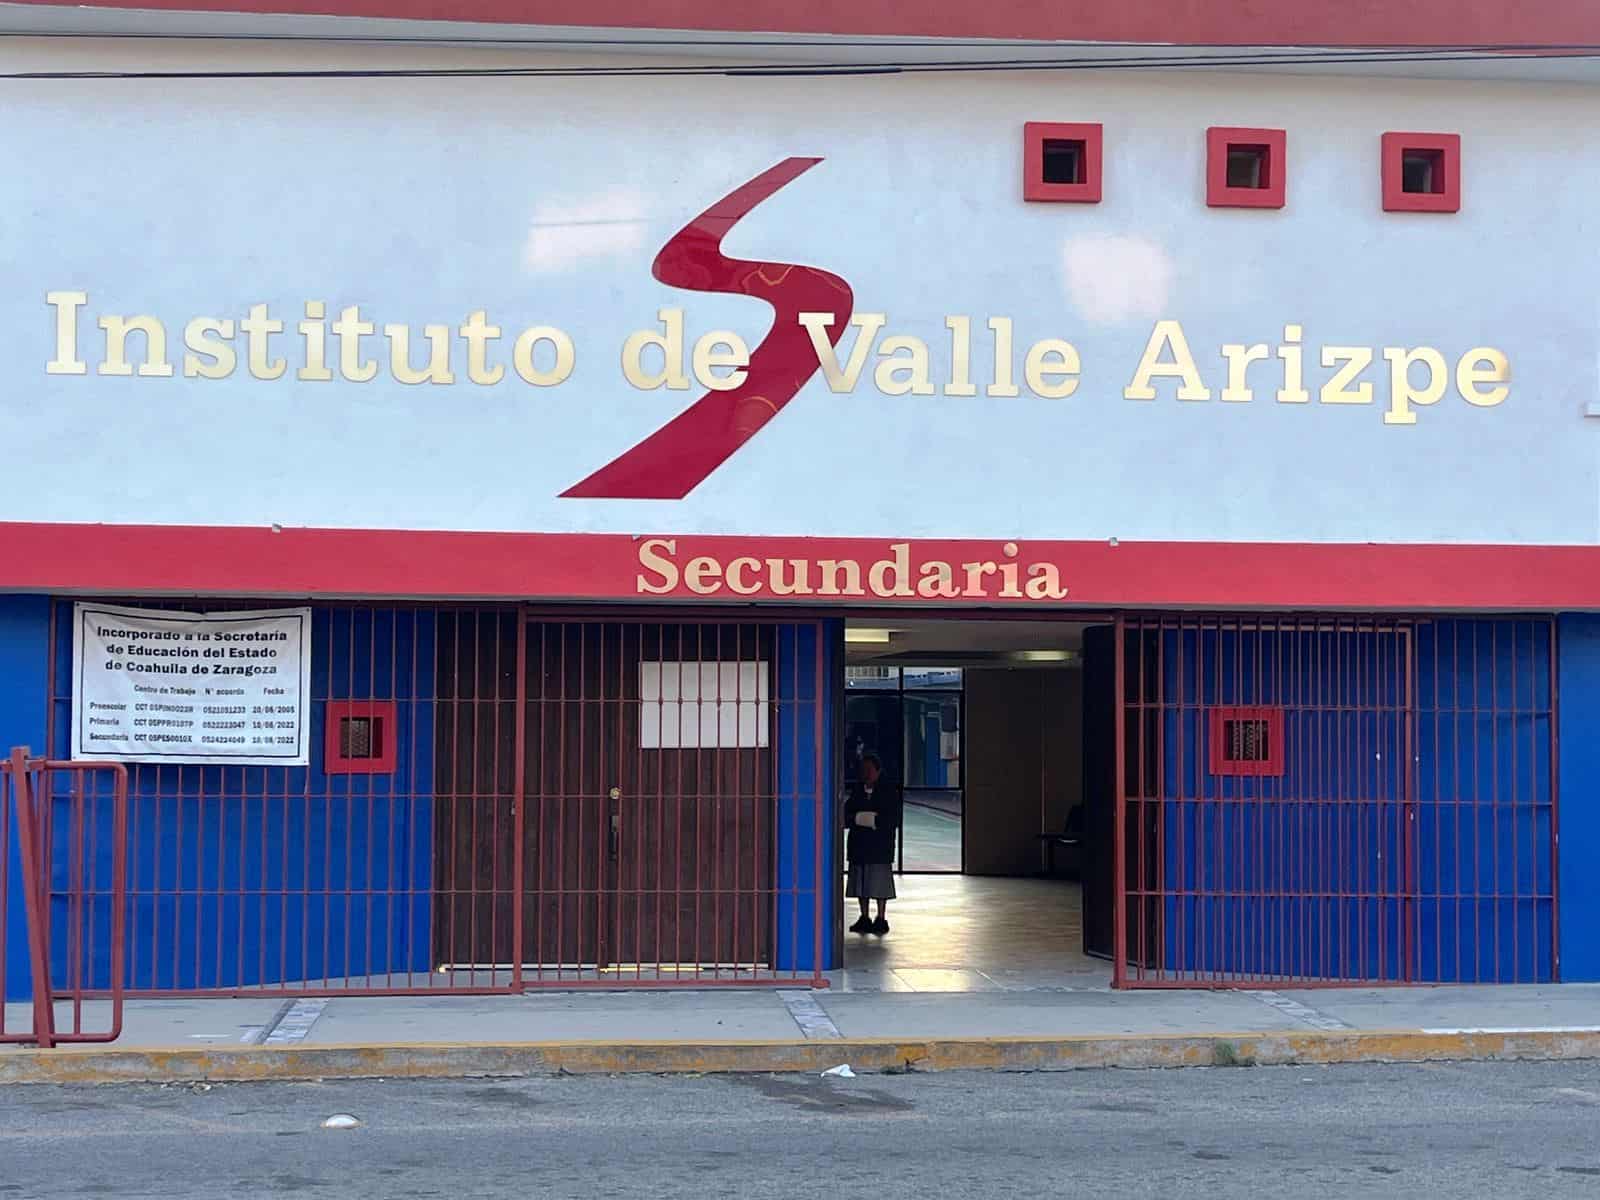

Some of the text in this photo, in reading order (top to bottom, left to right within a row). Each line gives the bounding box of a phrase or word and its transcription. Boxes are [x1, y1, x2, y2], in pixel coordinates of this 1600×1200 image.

[46, 290, 1512, 425] Instituto de Valle Arizpe
[636, 537, 1069, 600] Secundaria
[97, 626, 287, 641] Incorporado a la Secretaría
[106, 645, 277, 658] de Educación del Estado
[105, 660, 277, 676] de Coahuila de Zaragoza
[134, 684, 196, 696] Centro de Trabajo
[264, 687, 284, 695] Fecha
[135, 703, 148, 711] CCT
[89, 717, 120, 726] Primaria
[134, 734, 147, 742] CCT
